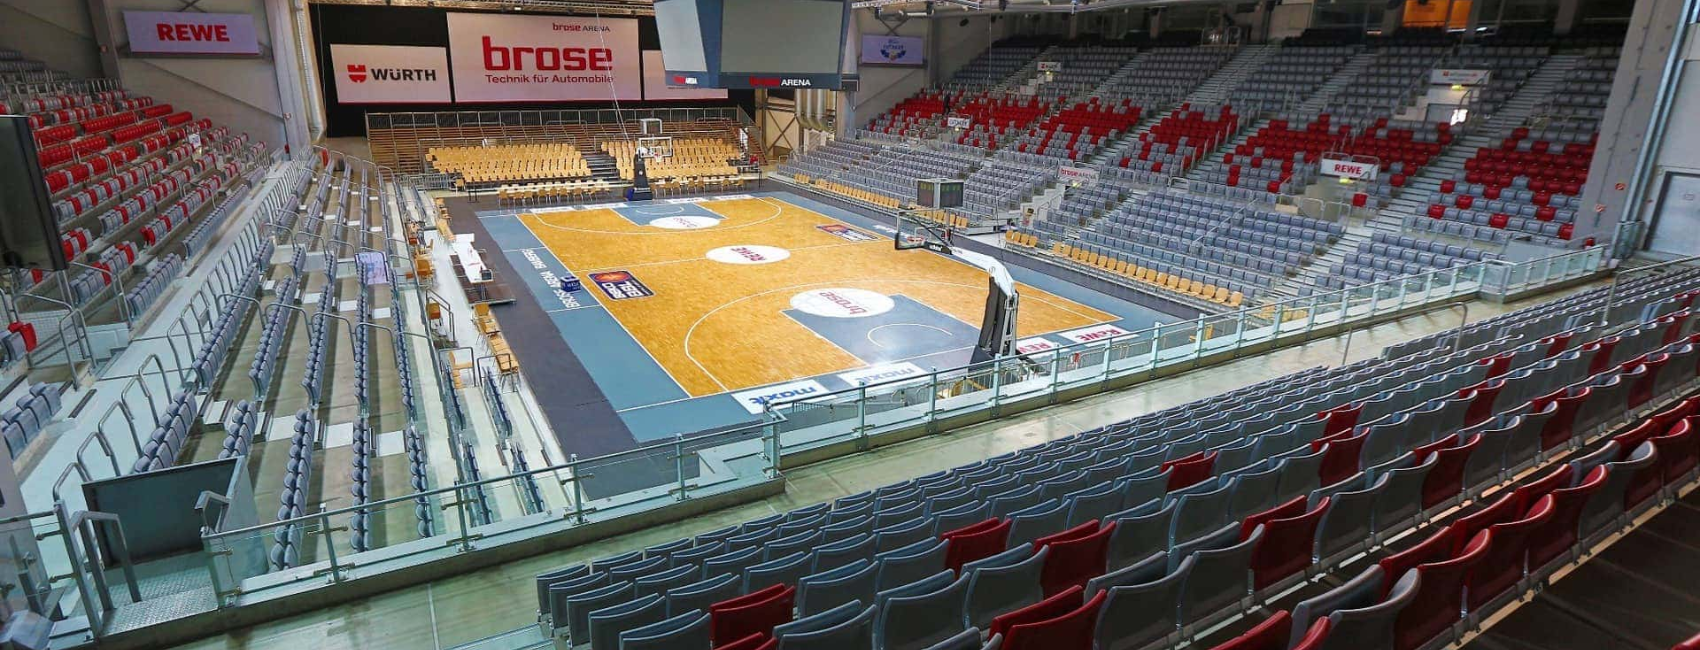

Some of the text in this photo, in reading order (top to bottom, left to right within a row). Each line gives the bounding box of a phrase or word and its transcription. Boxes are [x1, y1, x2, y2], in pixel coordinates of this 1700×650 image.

[156, 23, 231, 42] REWE
[552, 23, 581, 32] brose
[481, 36, 613, 71] brose
[371, 67, 437, 81] WÜRTH
[485, 74, 614, 84] Technik für Automobile
[780, 78, 811, 86] ARENA
[1334, 163, 1362, 174] REWE
[818, 291, 868, 314] brose
[748, 386, 818, 405] maxit
